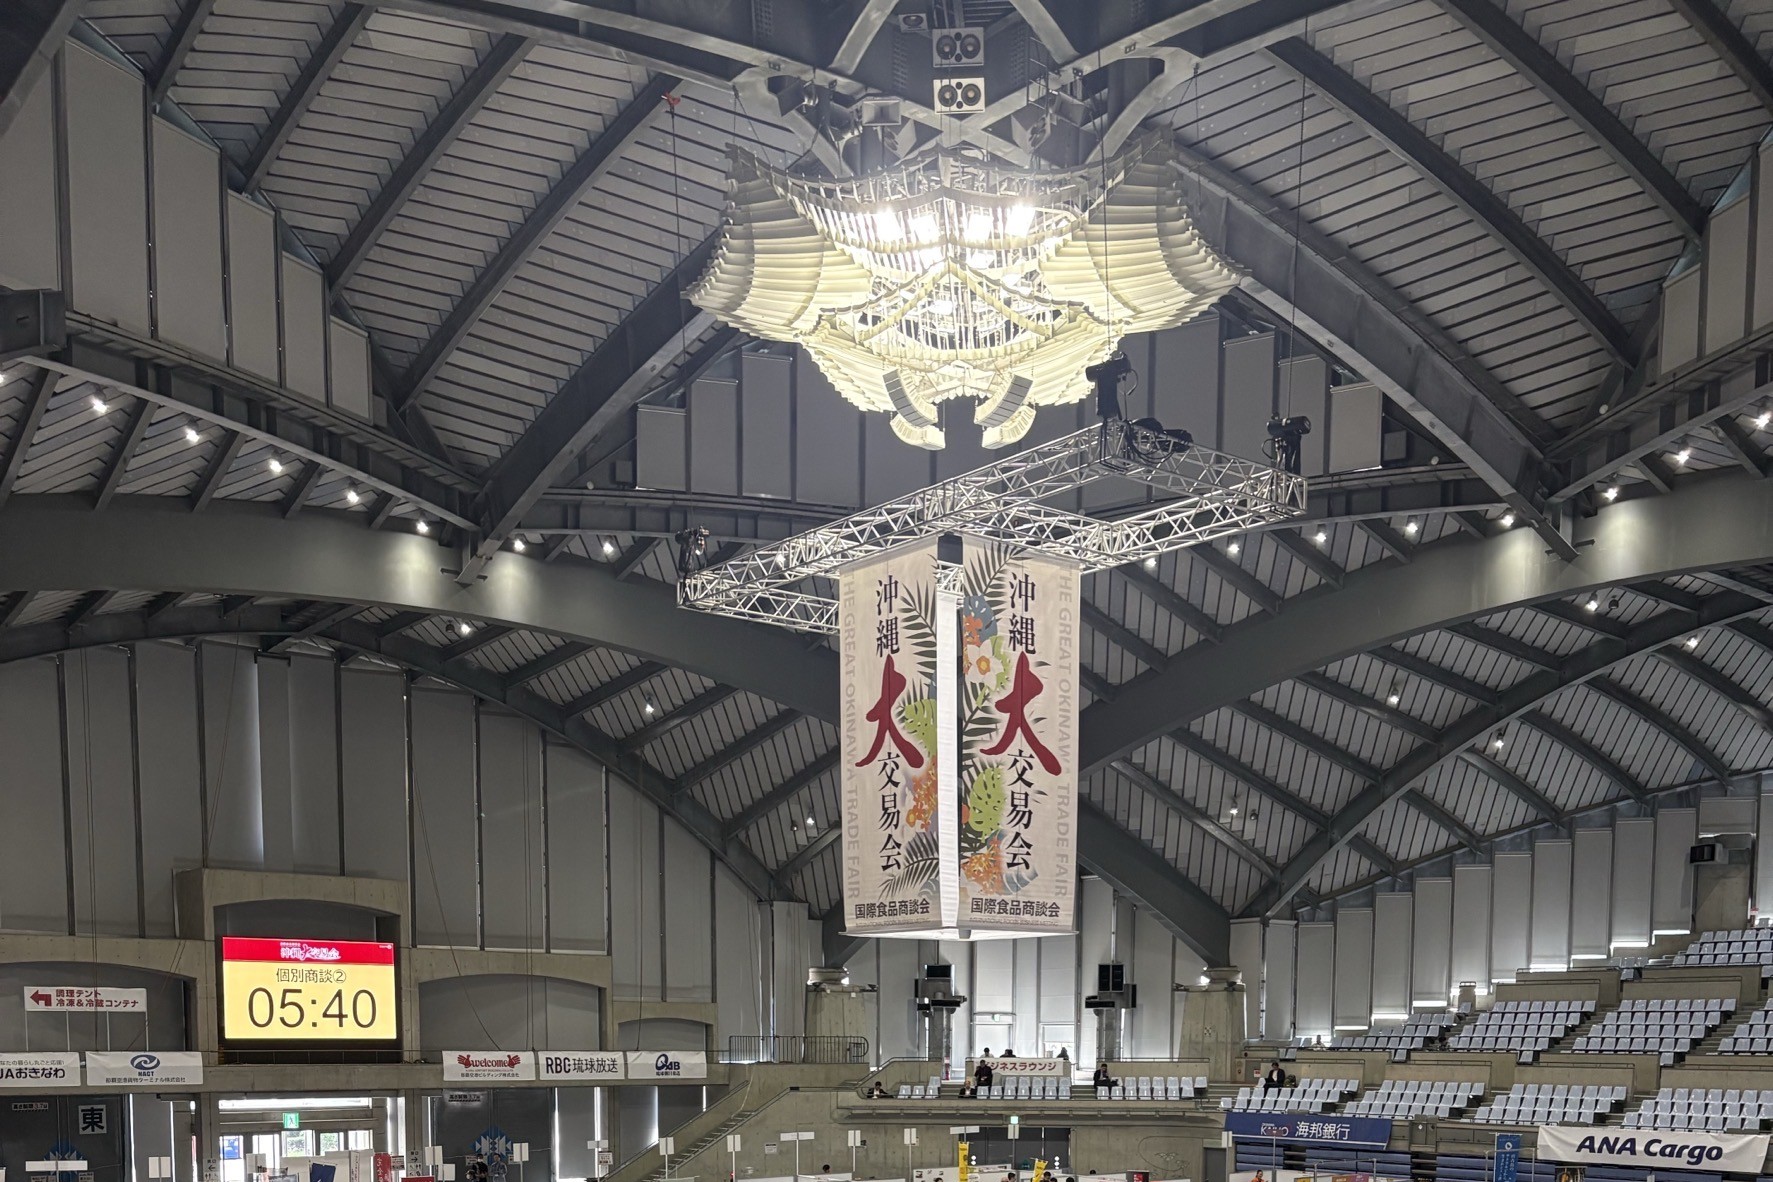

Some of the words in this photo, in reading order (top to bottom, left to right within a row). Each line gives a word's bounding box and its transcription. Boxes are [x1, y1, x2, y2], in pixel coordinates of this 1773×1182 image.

[844, 613, 856, 675] GREAT
[1059, 607, 1072, 674] GREAT
[845, 683, 857, 779] OKINAWA
[855, 574, 924, 870] 沖縄大交易会
[980, 572, 1062, 870] 沖縄大交易会
[847, 785, 860, 848] TRADE
[1057, 782, 1070, 843] TRADE
[847, 854, 860, 899] FAIR
[1056, 849, 1069, 897] FAIR
[855, 898, 930, 919] 国際食品商談会
[970, 897, 1060, 917] 国際食品商談会
[56, 989, 101, 998] 調理テント
[276, 968, 347, 983] 個別商談②
[248, 987, 377, 1028] 05:40
[470, 1058, 509, 1068] welcome
[573, 1058, 619, 1074] 琉球放送
[81, 1107, 104, 1132] 東
[1295, 1122, 1350, 1140] 海邦銀行
[1577, 1135, 1637, 1157] ANA
[1643, 1138, 1723, 1166] Cargo
